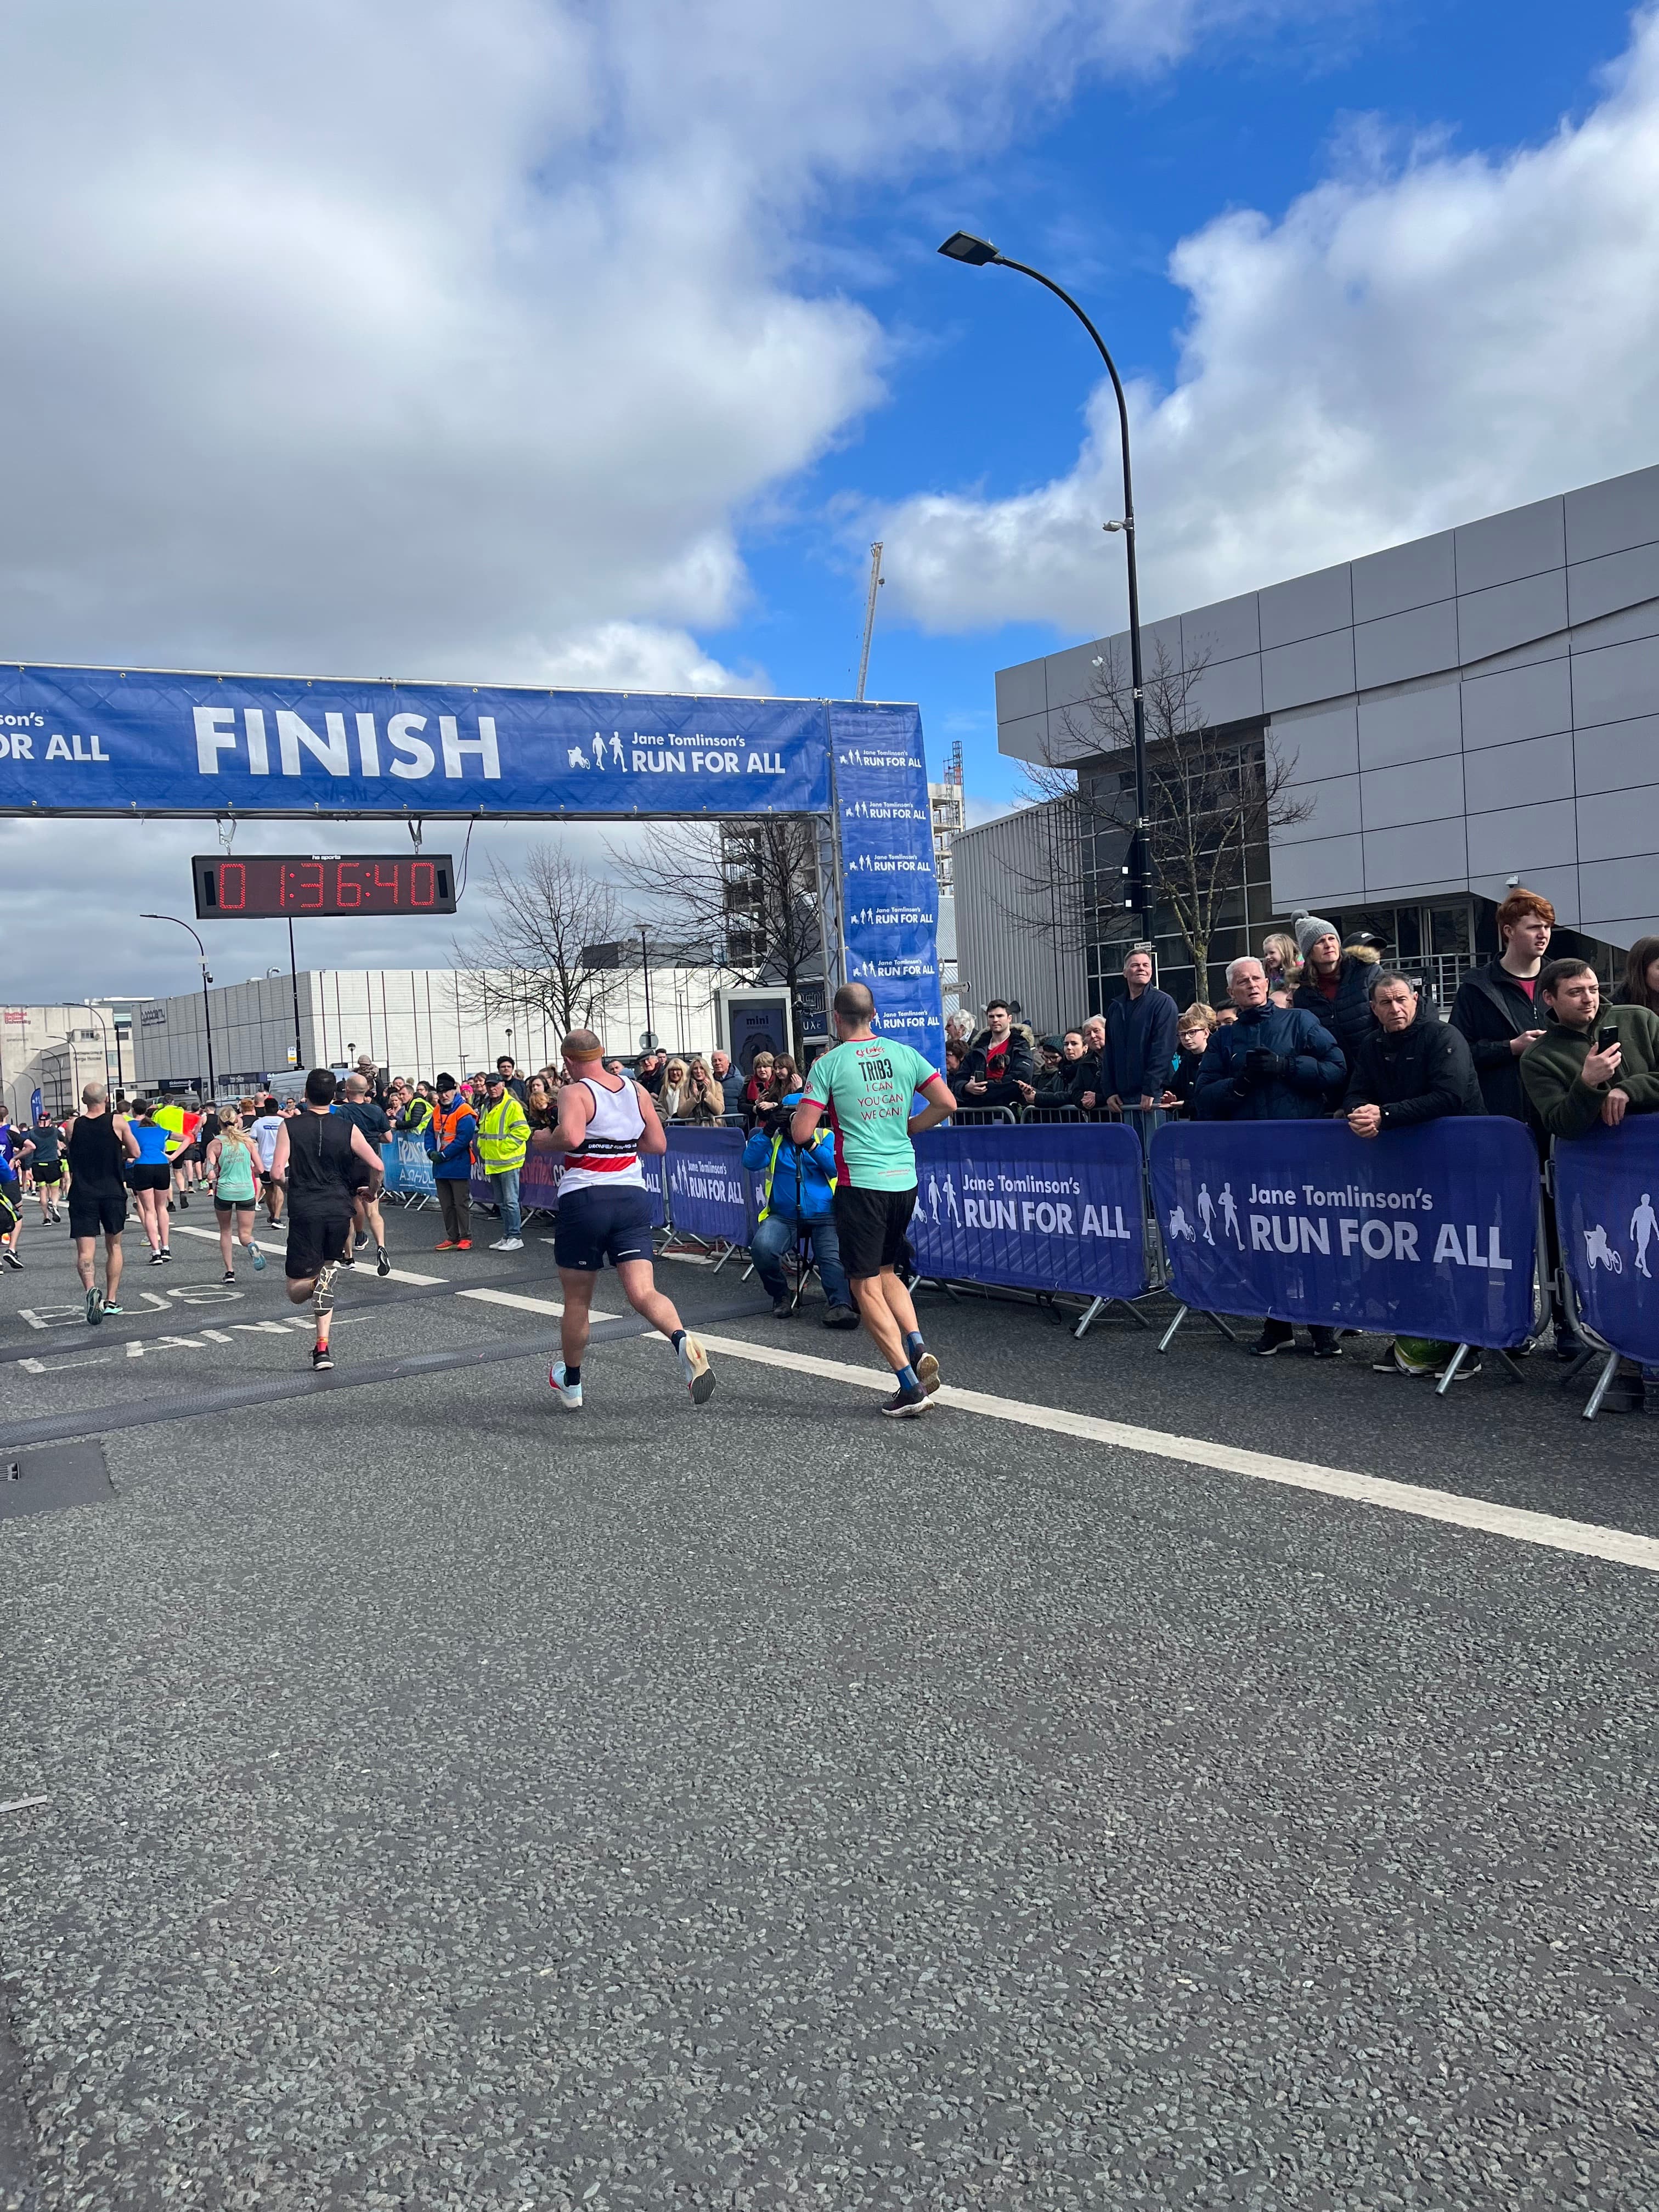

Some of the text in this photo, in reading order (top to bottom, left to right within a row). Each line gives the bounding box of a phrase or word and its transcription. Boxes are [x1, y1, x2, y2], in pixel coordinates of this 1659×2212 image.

[193, 706, 501, 780] FINISH
[631, 732, 746, 747] Jane Tomlinson's
[45, 734, 110, 761] ALL
[632, 750, 786, 774] RUN FOR ALL
[864, 757, 922, 768] RUN FOR ALL
[870, 809, 927, 820] RUN FOR ALL
[874, 861, 931, 871] RUN FOR ALL
[876, 914, 933, 924] RUN FOR ALL
[878, 965, 935, 977] RUN FOR ALL
[746, 1015, 769, 1025] mini
[803, 1020, 821, 1030] UXE
[883, 1017, 940, 1029] RUN FOR ALL
[858, 1058, 893, 1082] TRIB3
[866, 1081, 893, 1092] I CAN
[857, 1093, 904, 1107] YOU CAN
[860, 1107, 902, 1121] WE CAN!
[698, 1160, 727, 1175] Tomlinson's
[646, 1172, 661, 1193] ALL
[963, 1174, 1080, 1195] Jane Tomlinson's
[689, 1176, 744, 1205] RUN FOR ALL
[1249, 1183, 1433, 1210] Jane Tomlinson's
[964, 1199, 1131, 1239] RUN FOR ALL
[1249, 1214, 1513, 1271] RUN FOR ALL
